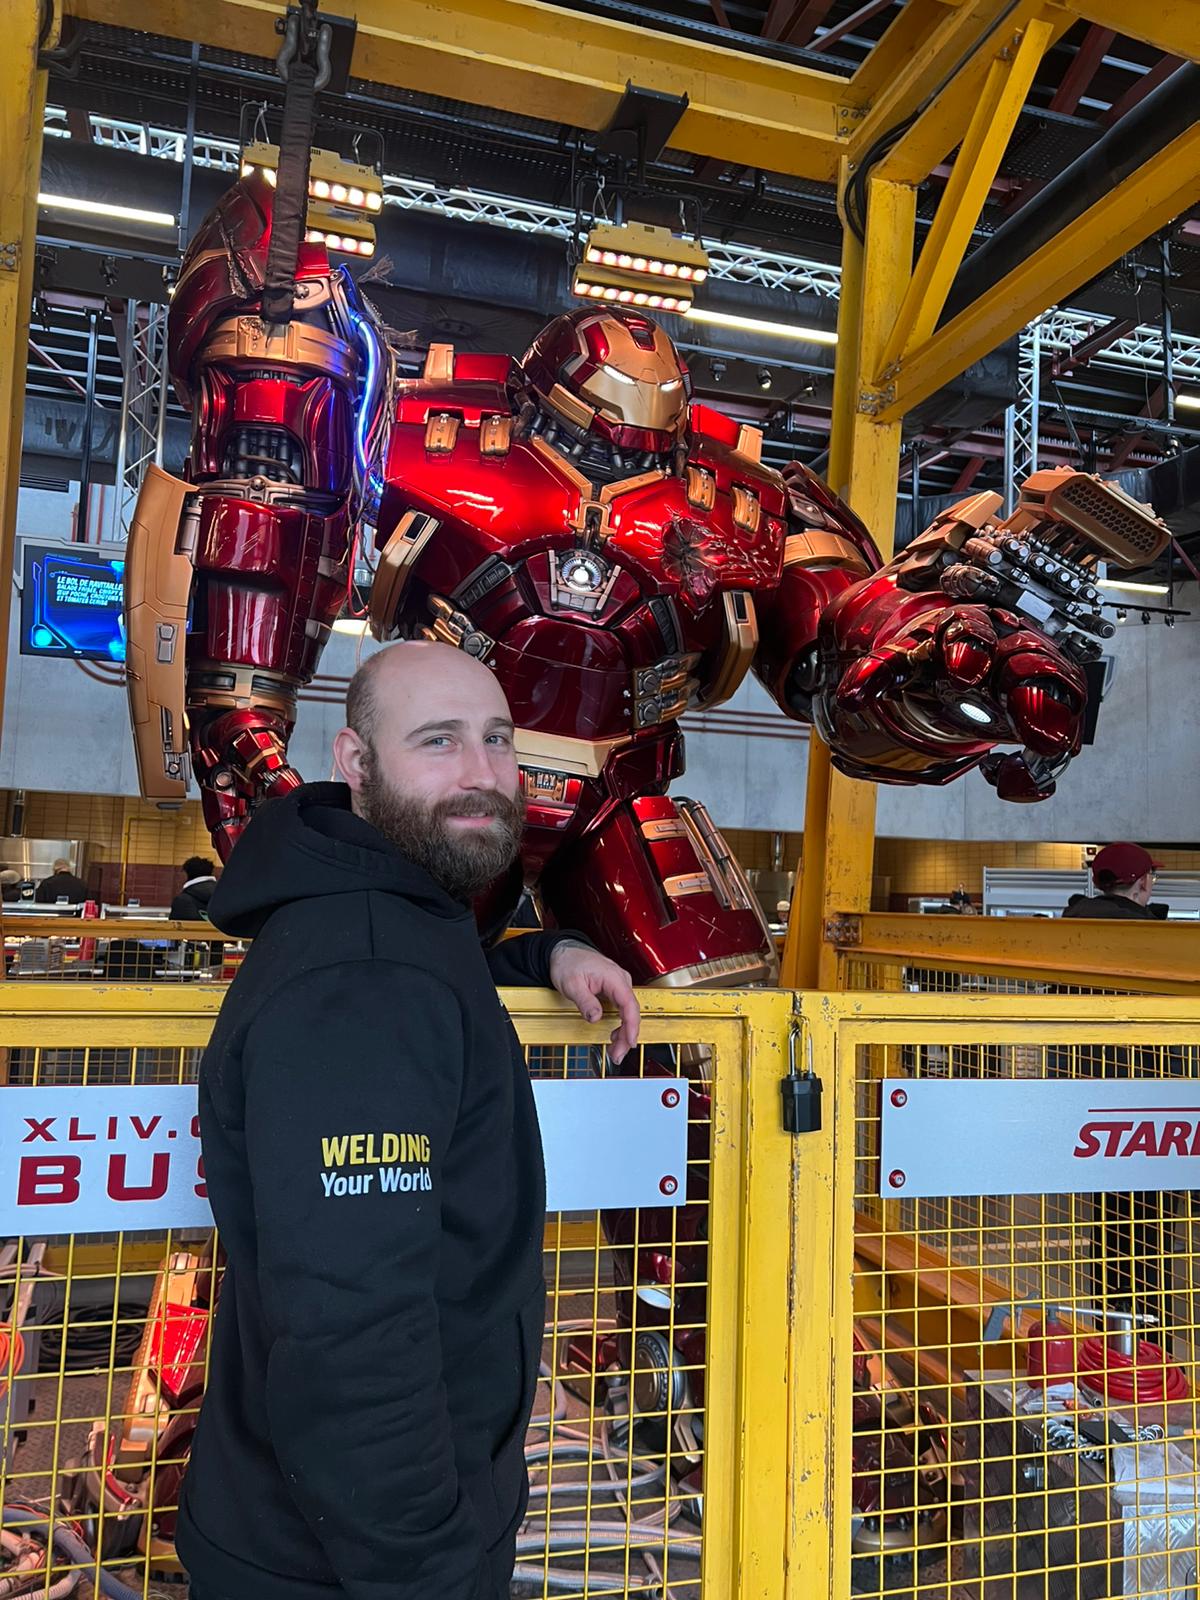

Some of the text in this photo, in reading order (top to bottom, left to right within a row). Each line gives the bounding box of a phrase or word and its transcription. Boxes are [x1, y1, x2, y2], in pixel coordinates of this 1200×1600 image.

[321, 1133, 431, 1167] WELDING
[17, 1152, 208, 1205] BU
[321, 1167, 433, 1197] Your World
